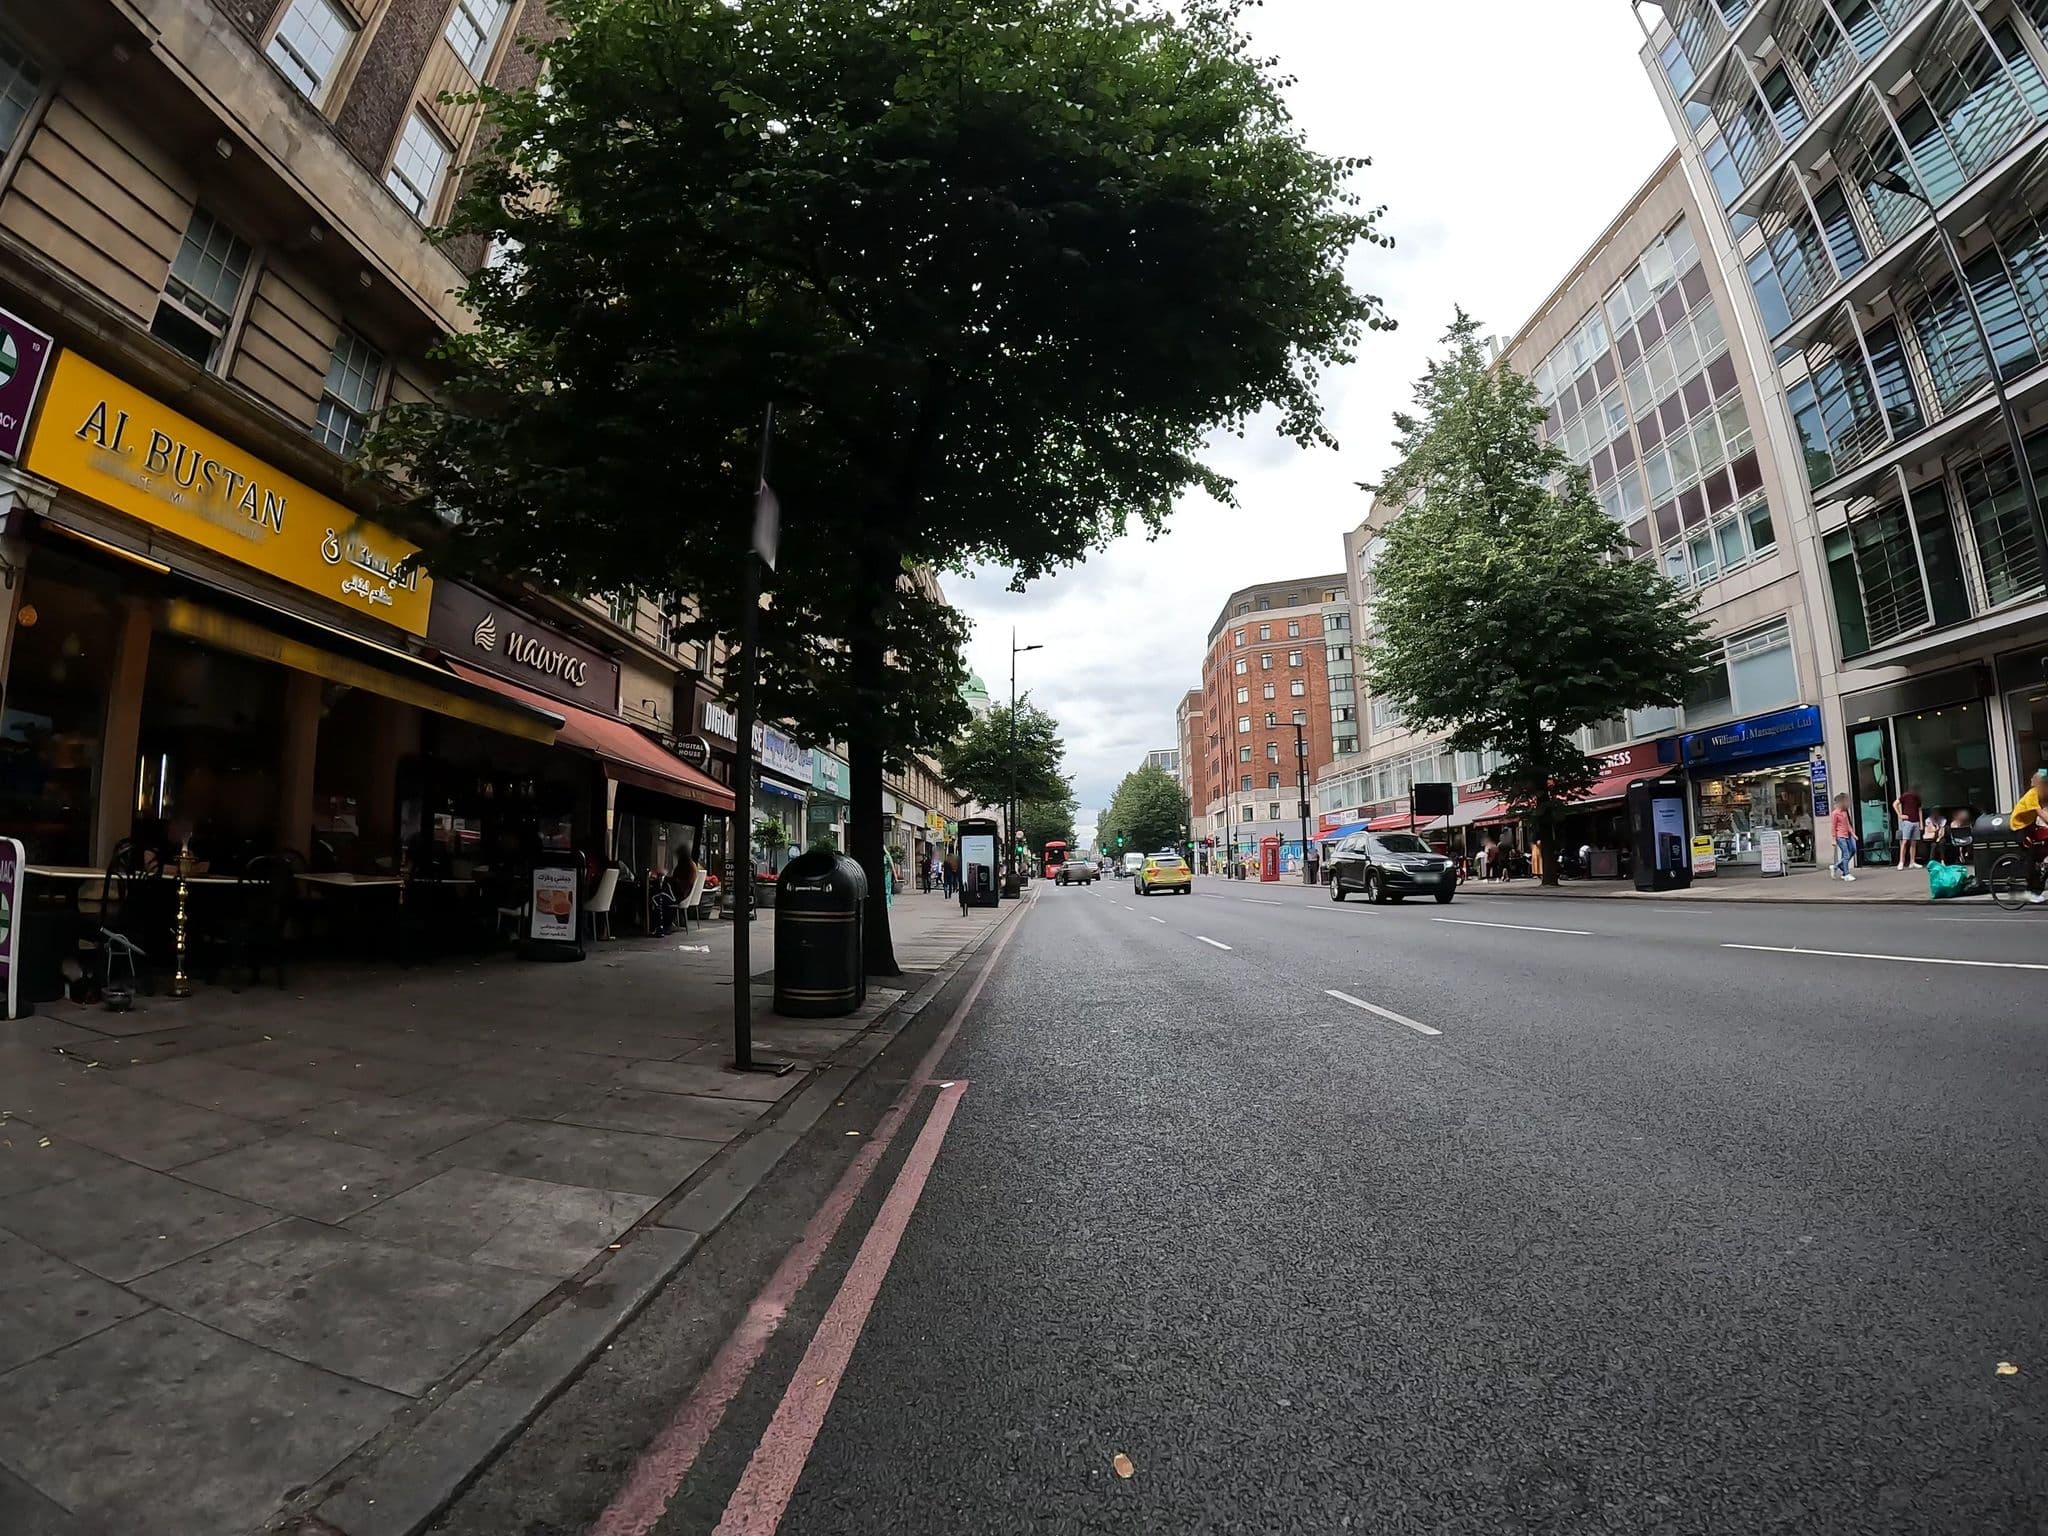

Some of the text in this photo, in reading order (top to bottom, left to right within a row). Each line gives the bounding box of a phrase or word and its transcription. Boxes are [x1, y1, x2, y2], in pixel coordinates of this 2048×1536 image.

[75, 400, 134, 456] AL
[145, 428, 288, 534] BUSTAN
[508, 631, 588, 687] nawras
[704, 702, 738, 742] DIGITAL
[678, 742, 704, 751] DIGITAL
[678, 749, 701, 758] HOUSE
